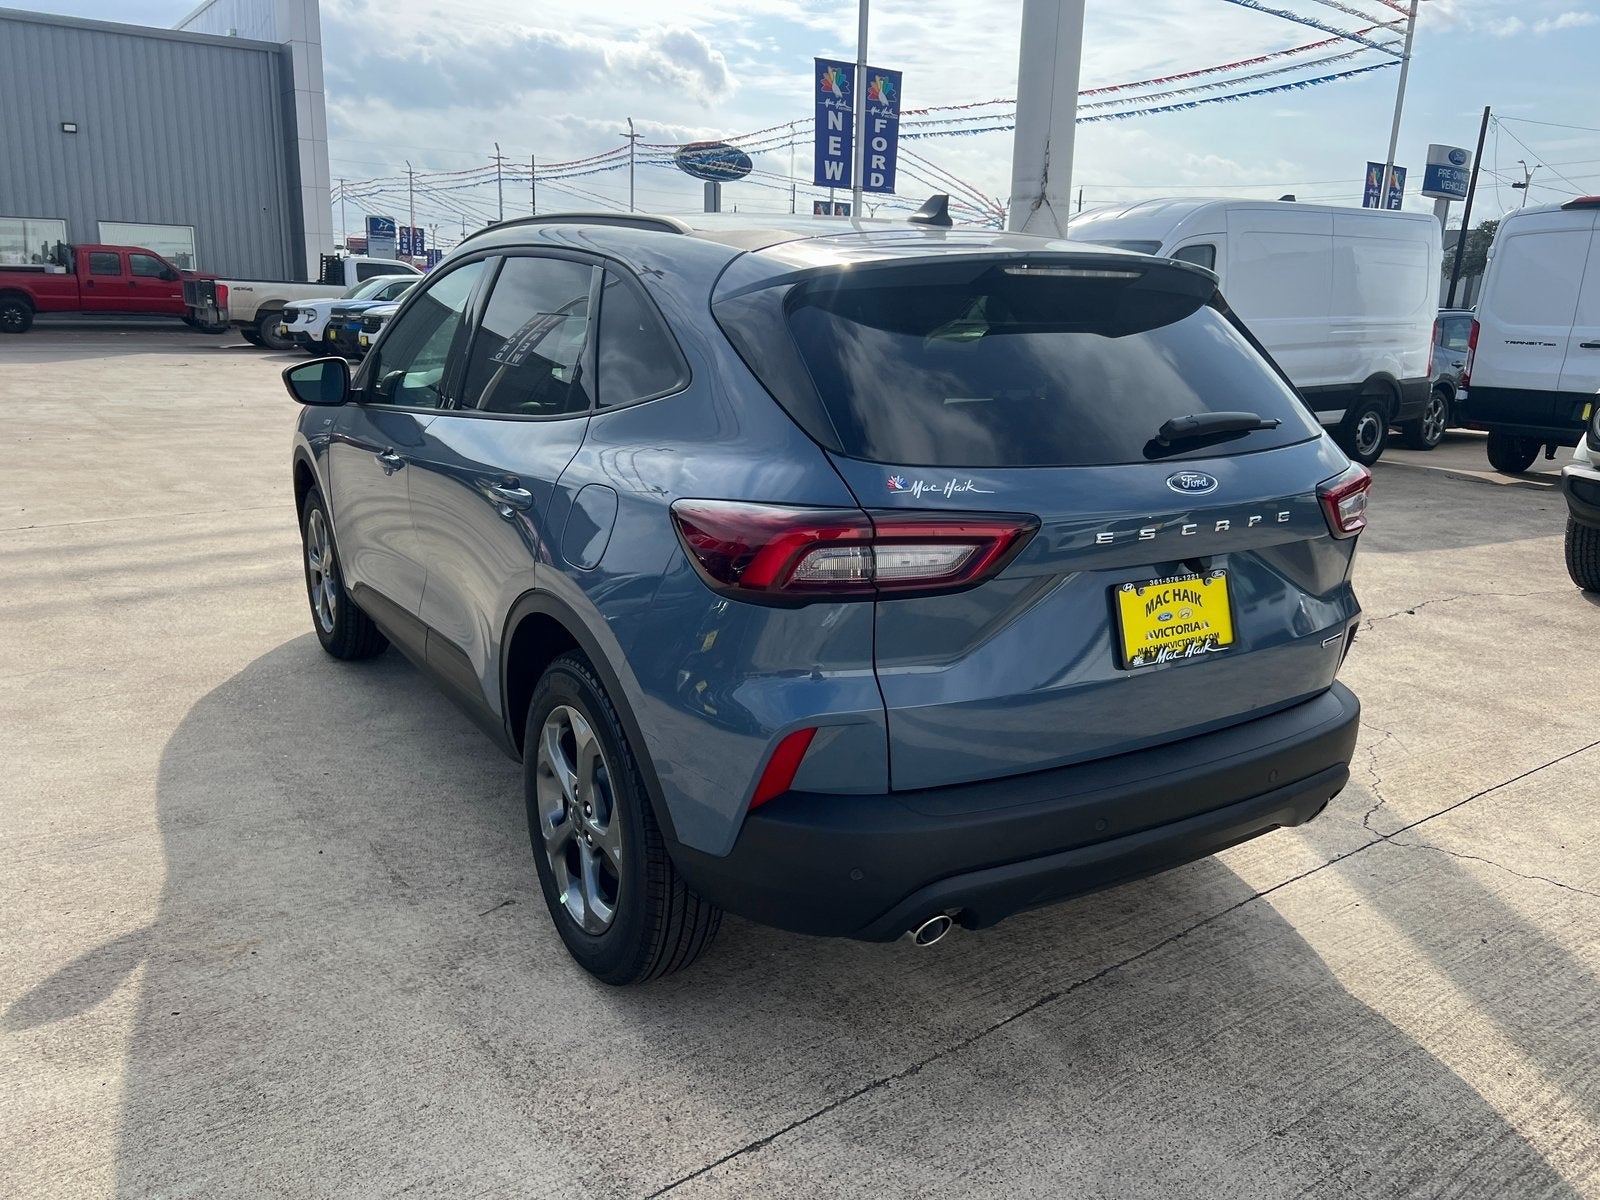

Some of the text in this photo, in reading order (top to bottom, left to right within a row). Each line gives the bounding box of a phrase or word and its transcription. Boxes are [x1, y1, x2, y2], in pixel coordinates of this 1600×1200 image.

[824, 110, 844, 181] NEW
[870, 118, 888, 187] FORD
[1441, 180, 1466, 193] VEHICLES
[901, 478, 986, 499] Mac Haik
[1181, 475, 1209, 488] Ford
[1095, 510, 1291, 545] ESCAPE
[1145, 588, 1203, 618] MAC HAIK
[1153, 621, 1201, 639] VICTORIA
[1146, 639, 1220, 664] Mac Haik
